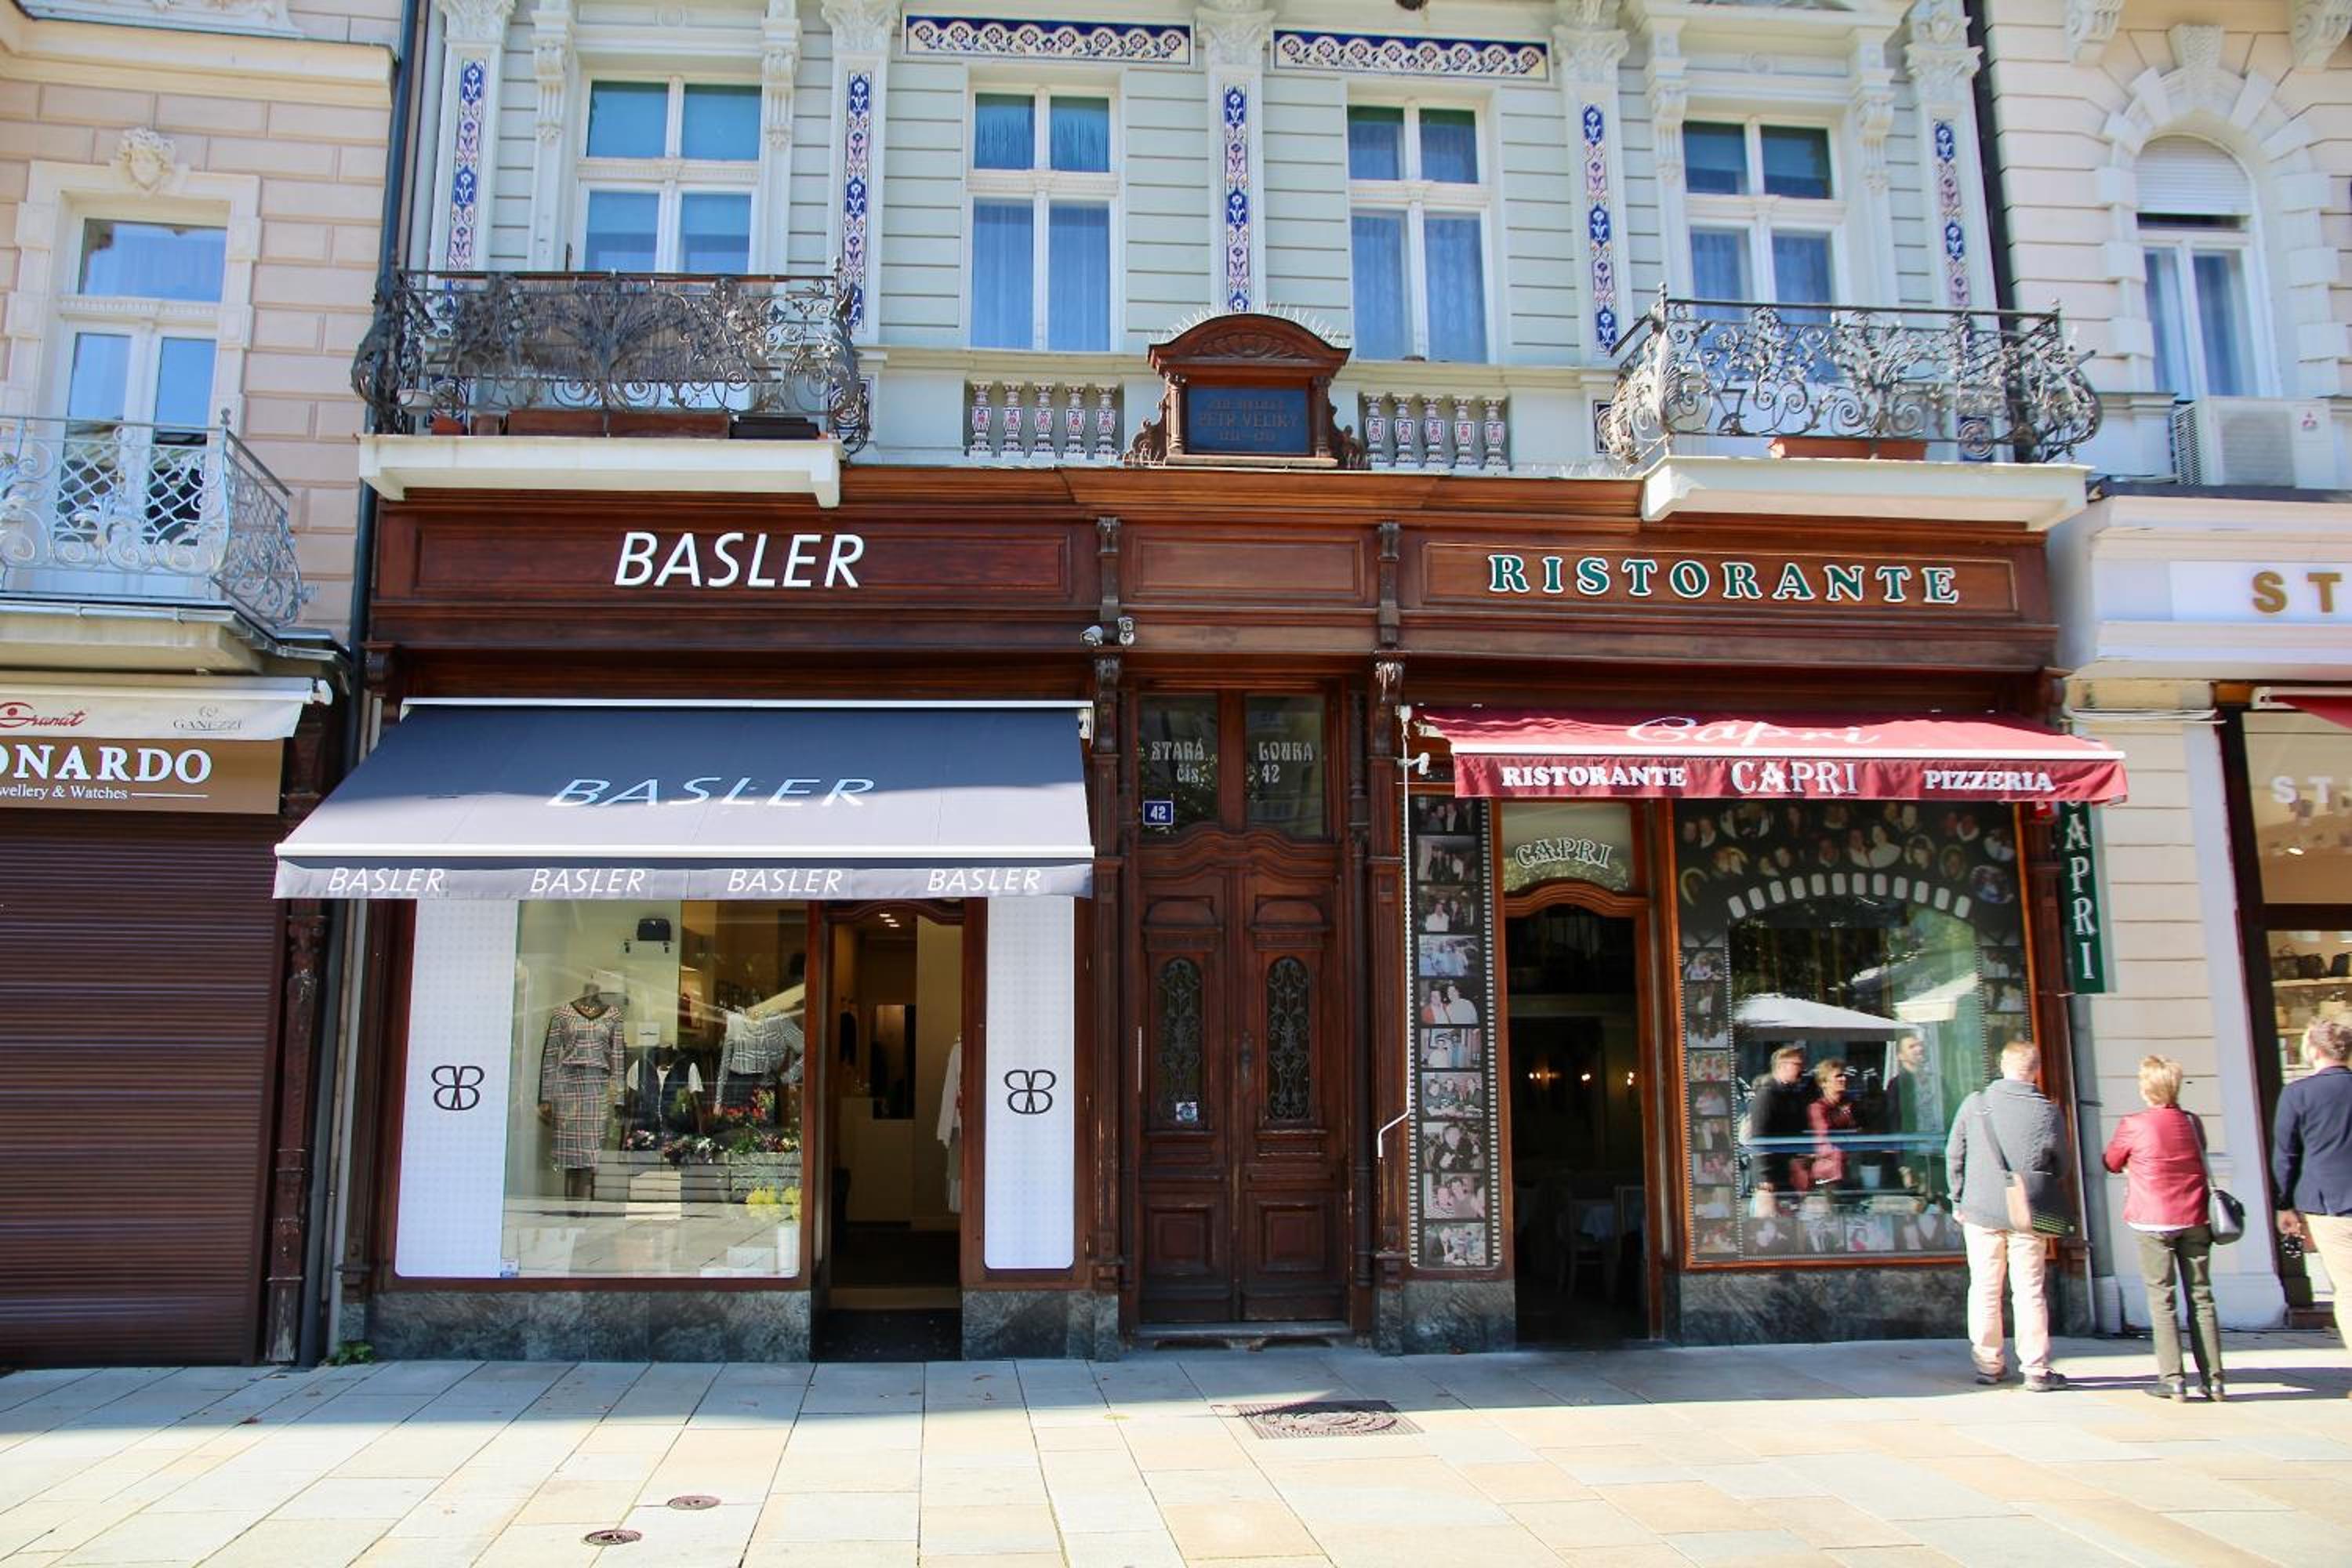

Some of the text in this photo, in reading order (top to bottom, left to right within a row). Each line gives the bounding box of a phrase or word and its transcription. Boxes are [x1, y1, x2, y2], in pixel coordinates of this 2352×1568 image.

[614, 532, 865, 588] BASLER
[1487, 554, 1959, 604] RISTORANTE
[2252, 571, 2342, 614] ST
[1625, 717, 1880, 747] Capri
[1262, 764, 1279, 783] 42
[1502, 761, 2056, 795] RISTORANTE CAPRI PIZZERIA
[53, 785, 65, 798] &
[71, 785, 128, 800] Watches
[546, 777, 875, 808] BASLER
[1150, 805, 1166, 821] 42
[1515, 837, 1613, 869] CAPRI
[328, 868, 1042, 894] BASLER BASLER BASLER BASLER
[2065, 800, 2096, 980] APRI
